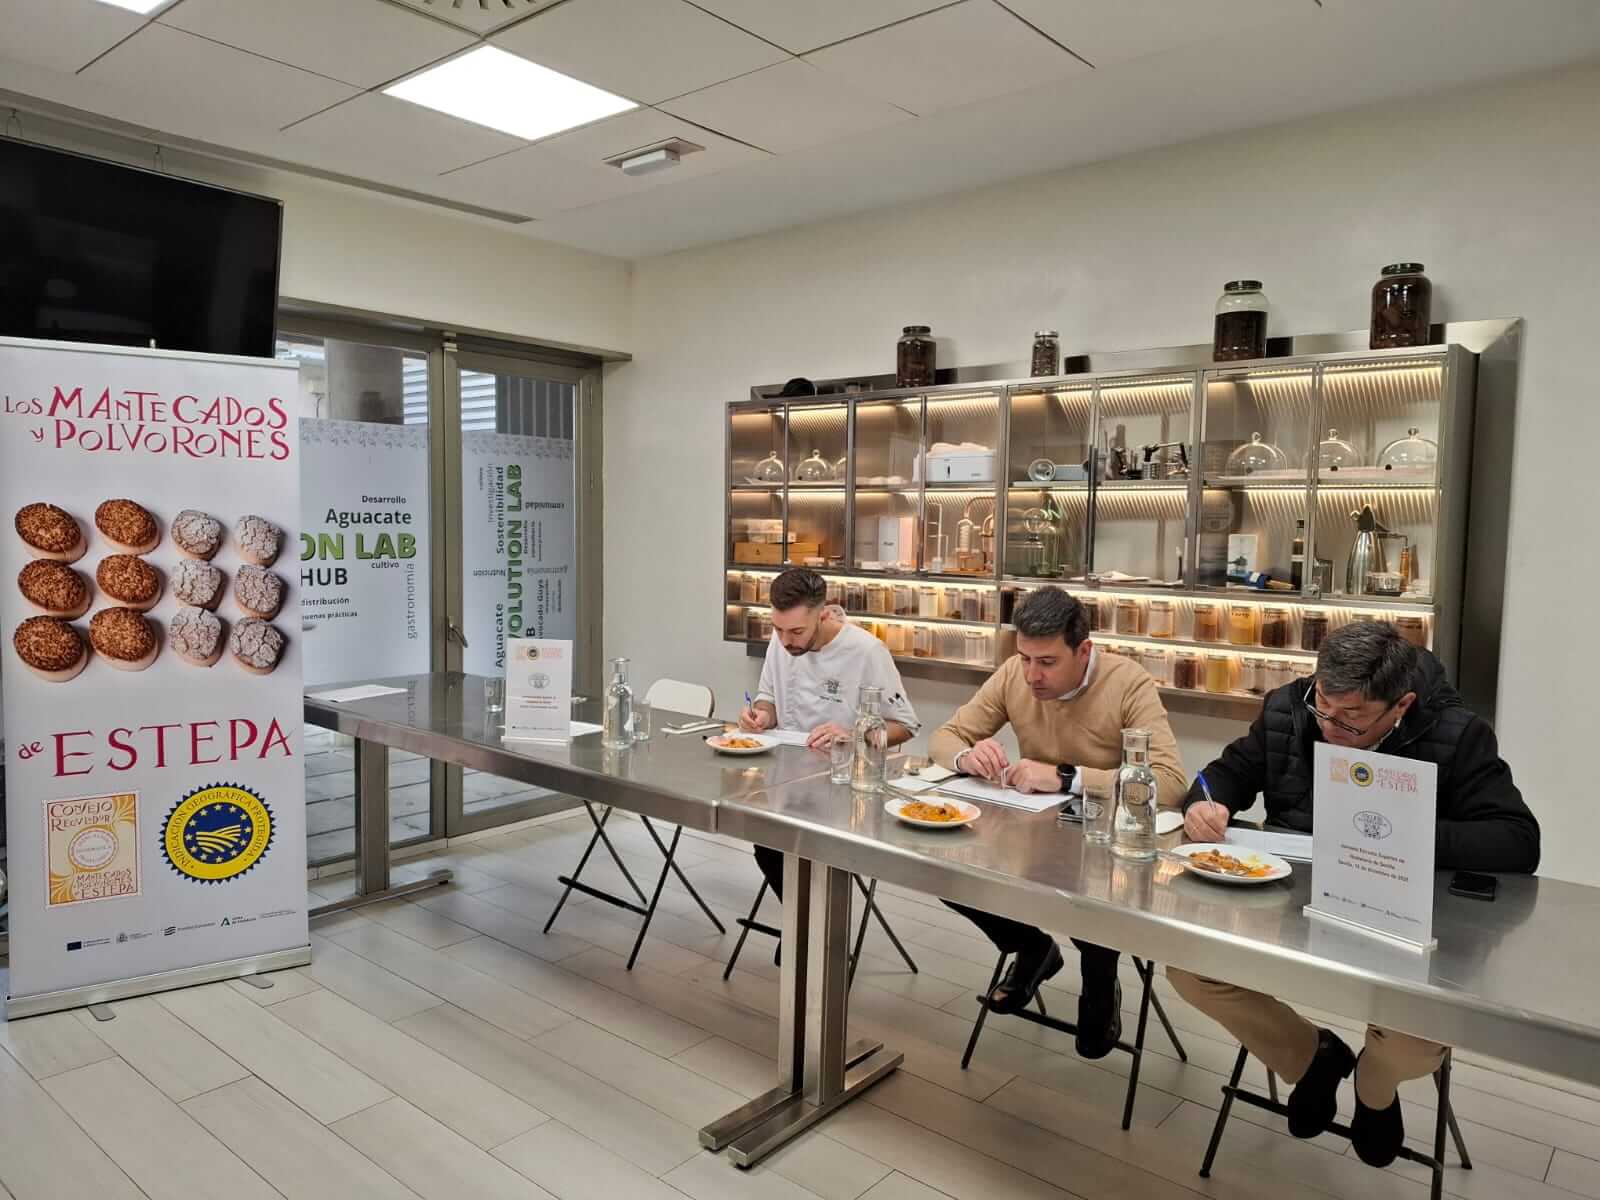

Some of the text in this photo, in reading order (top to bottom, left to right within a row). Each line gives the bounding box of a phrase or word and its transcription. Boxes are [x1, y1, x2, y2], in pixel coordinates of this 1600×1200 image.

[4, 386, 288, 430] LOS MANTECADOS
[54, 419, 290, 460] POLVORONES
[361, 495, 407, 504] Desarrollo
[507, 464, 522, 512] LAB
[325, 508, 412, 528] Aguacate
[496, 466, 504, 554] Sostenibilidad
[355, 533, 417, 560] LAB
[371, 560, 400, 569] cultivo
[496, 603, 506, 668] Aguacate
[18, 717, 293, 777] de ESTEPA
